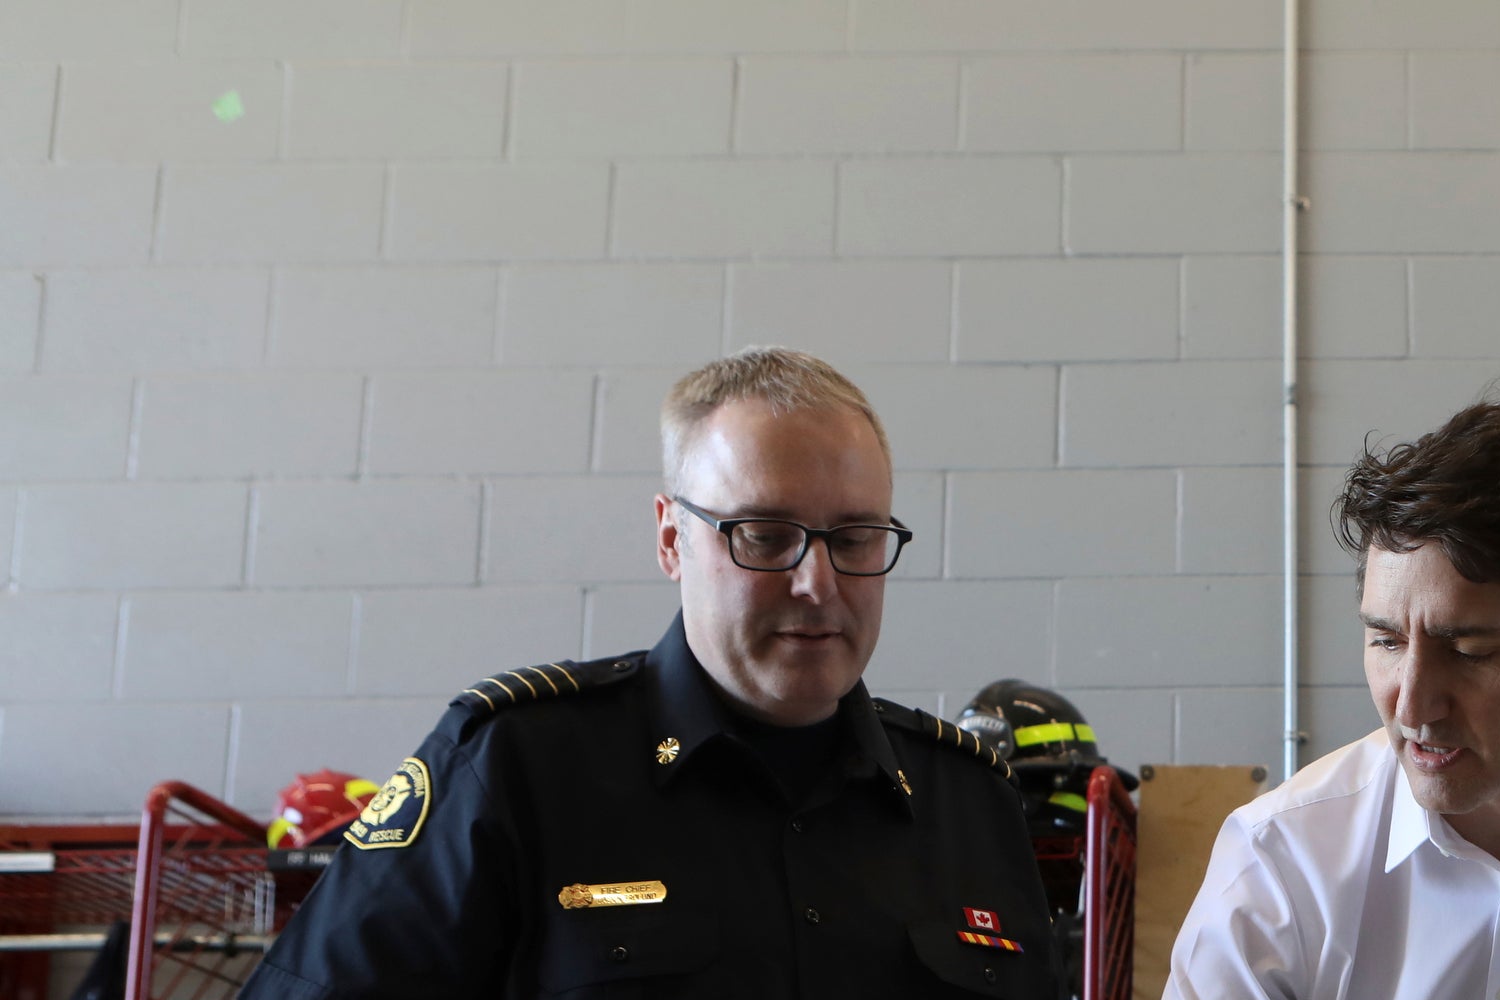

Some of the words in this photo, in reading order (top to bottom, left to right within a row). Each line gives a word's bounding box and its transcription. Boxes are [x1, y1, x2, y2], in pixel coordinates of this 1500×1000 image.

[368, 828, 405, 842] RESCUE
[600, 886, 621, 895] FIRE
[625, 884, 651, 893] CHIEF
